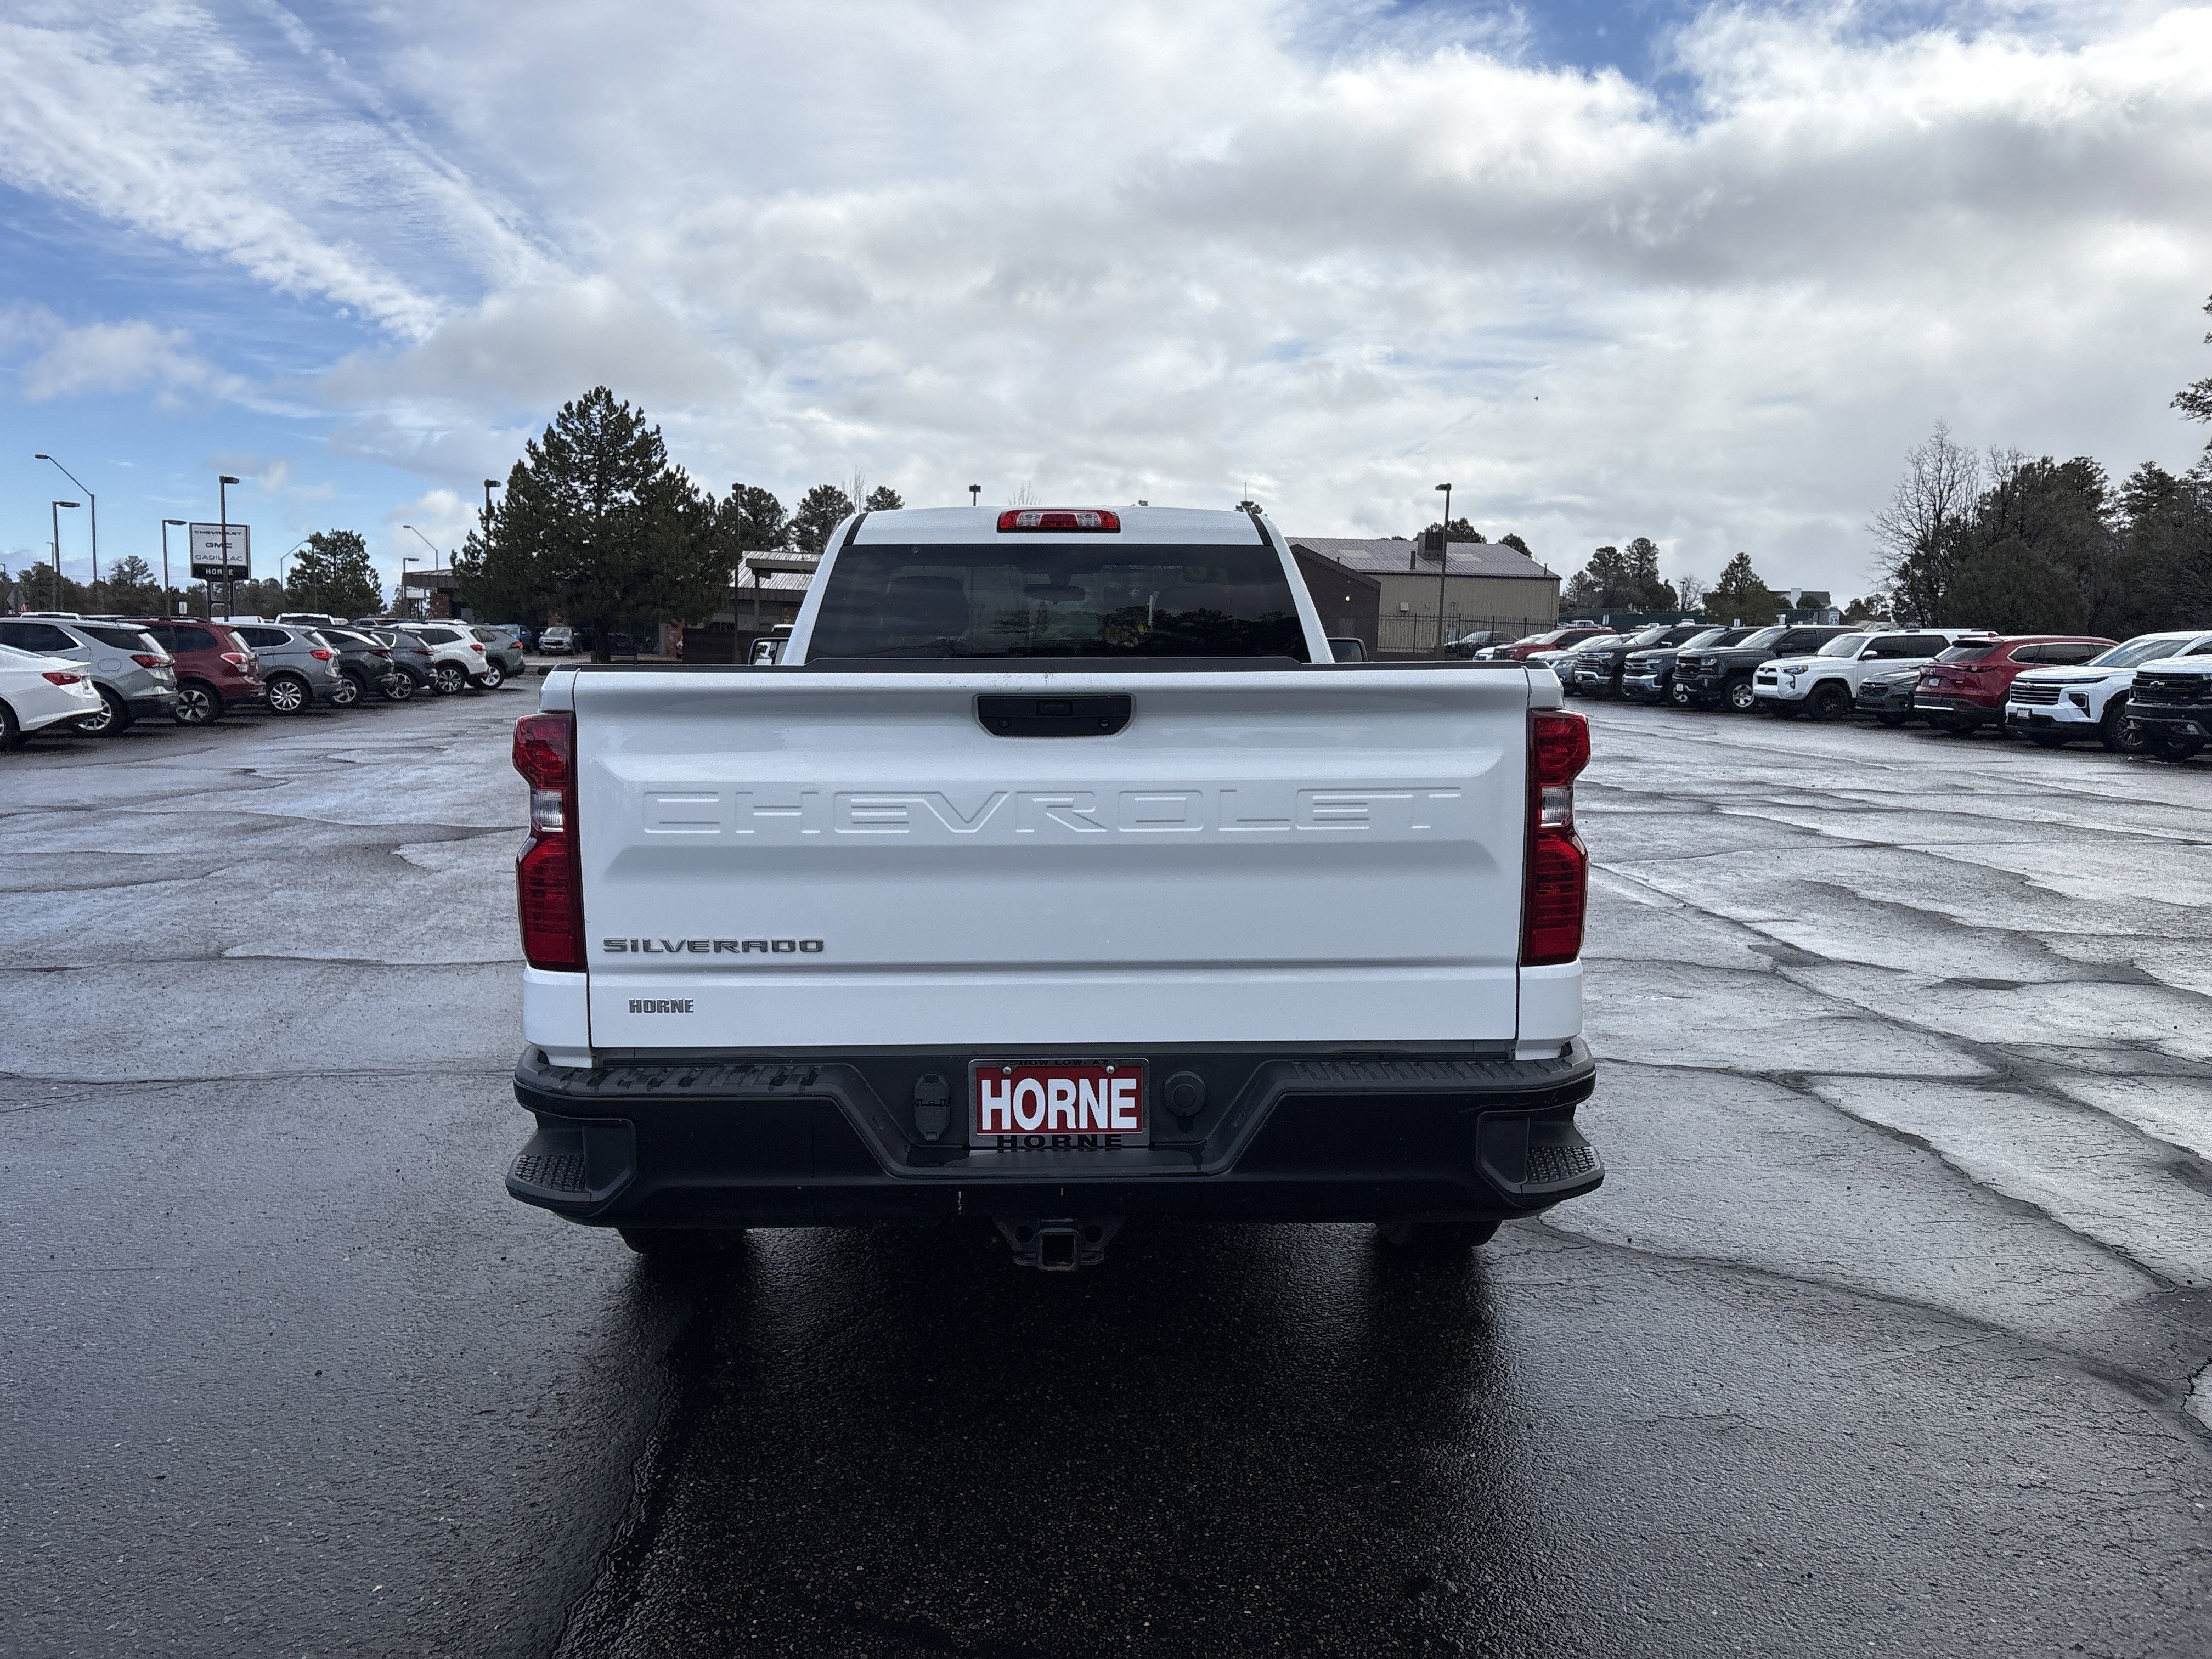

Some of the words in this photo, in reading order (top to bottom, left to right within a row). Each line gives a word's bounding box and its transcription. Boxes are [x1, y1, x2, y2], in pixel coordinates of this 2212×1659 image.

[644, 787, 1461, 833] CHEVROLET
[603, 938, 823, 953] SILVERADO
[629, 998, 694, 1013] HORNE
[981, 1077, 1137, 1130] HORNE
[997, 1134, 1122, 1148] HORNE
